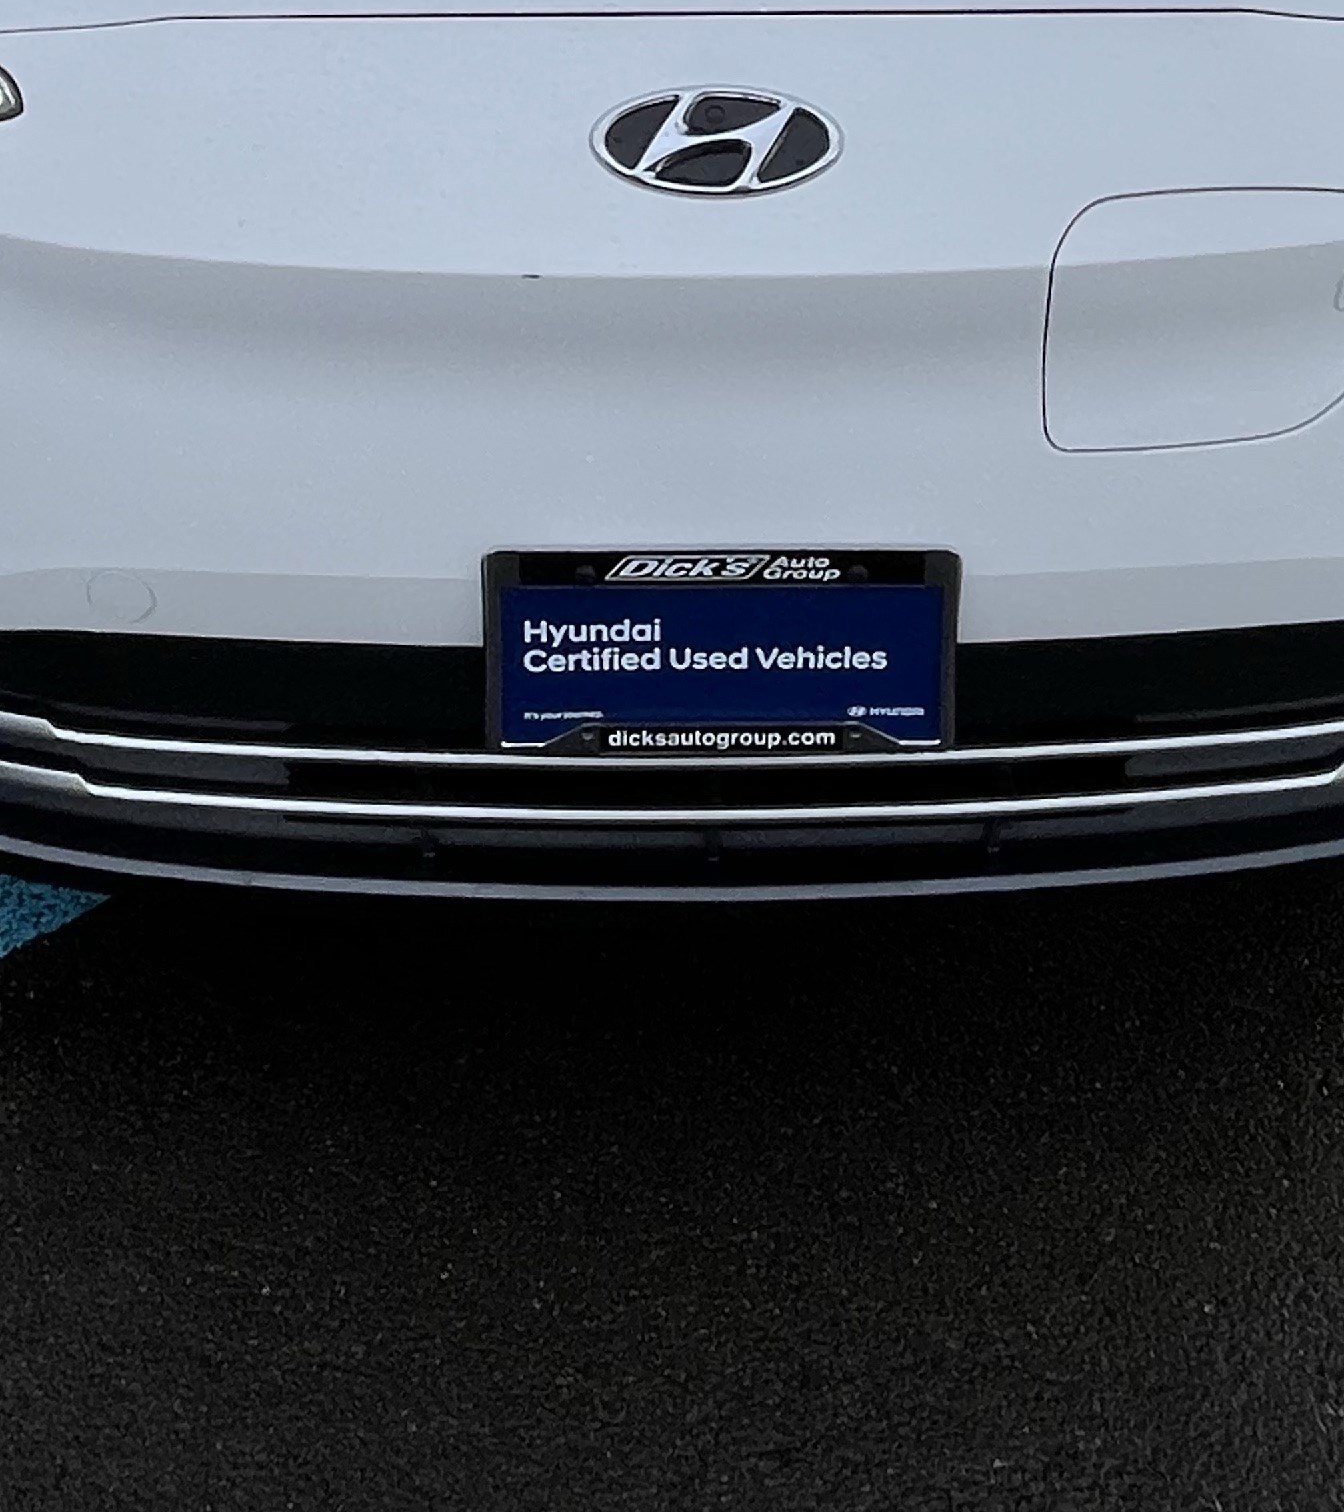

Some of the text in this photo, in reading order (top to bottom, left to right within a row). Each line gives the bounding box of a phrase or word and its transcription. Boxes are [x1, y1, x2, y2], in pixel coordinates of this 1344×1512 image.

[619, 556, 830, 577] Dick's Auto
[763, 568, 841, 581] Group
[523, 618, 661, 647] Hyundai
[523, 645, 888, 672] Certified Used Vehicles
[608, 730, 836, 750] dicksautogroup.com
